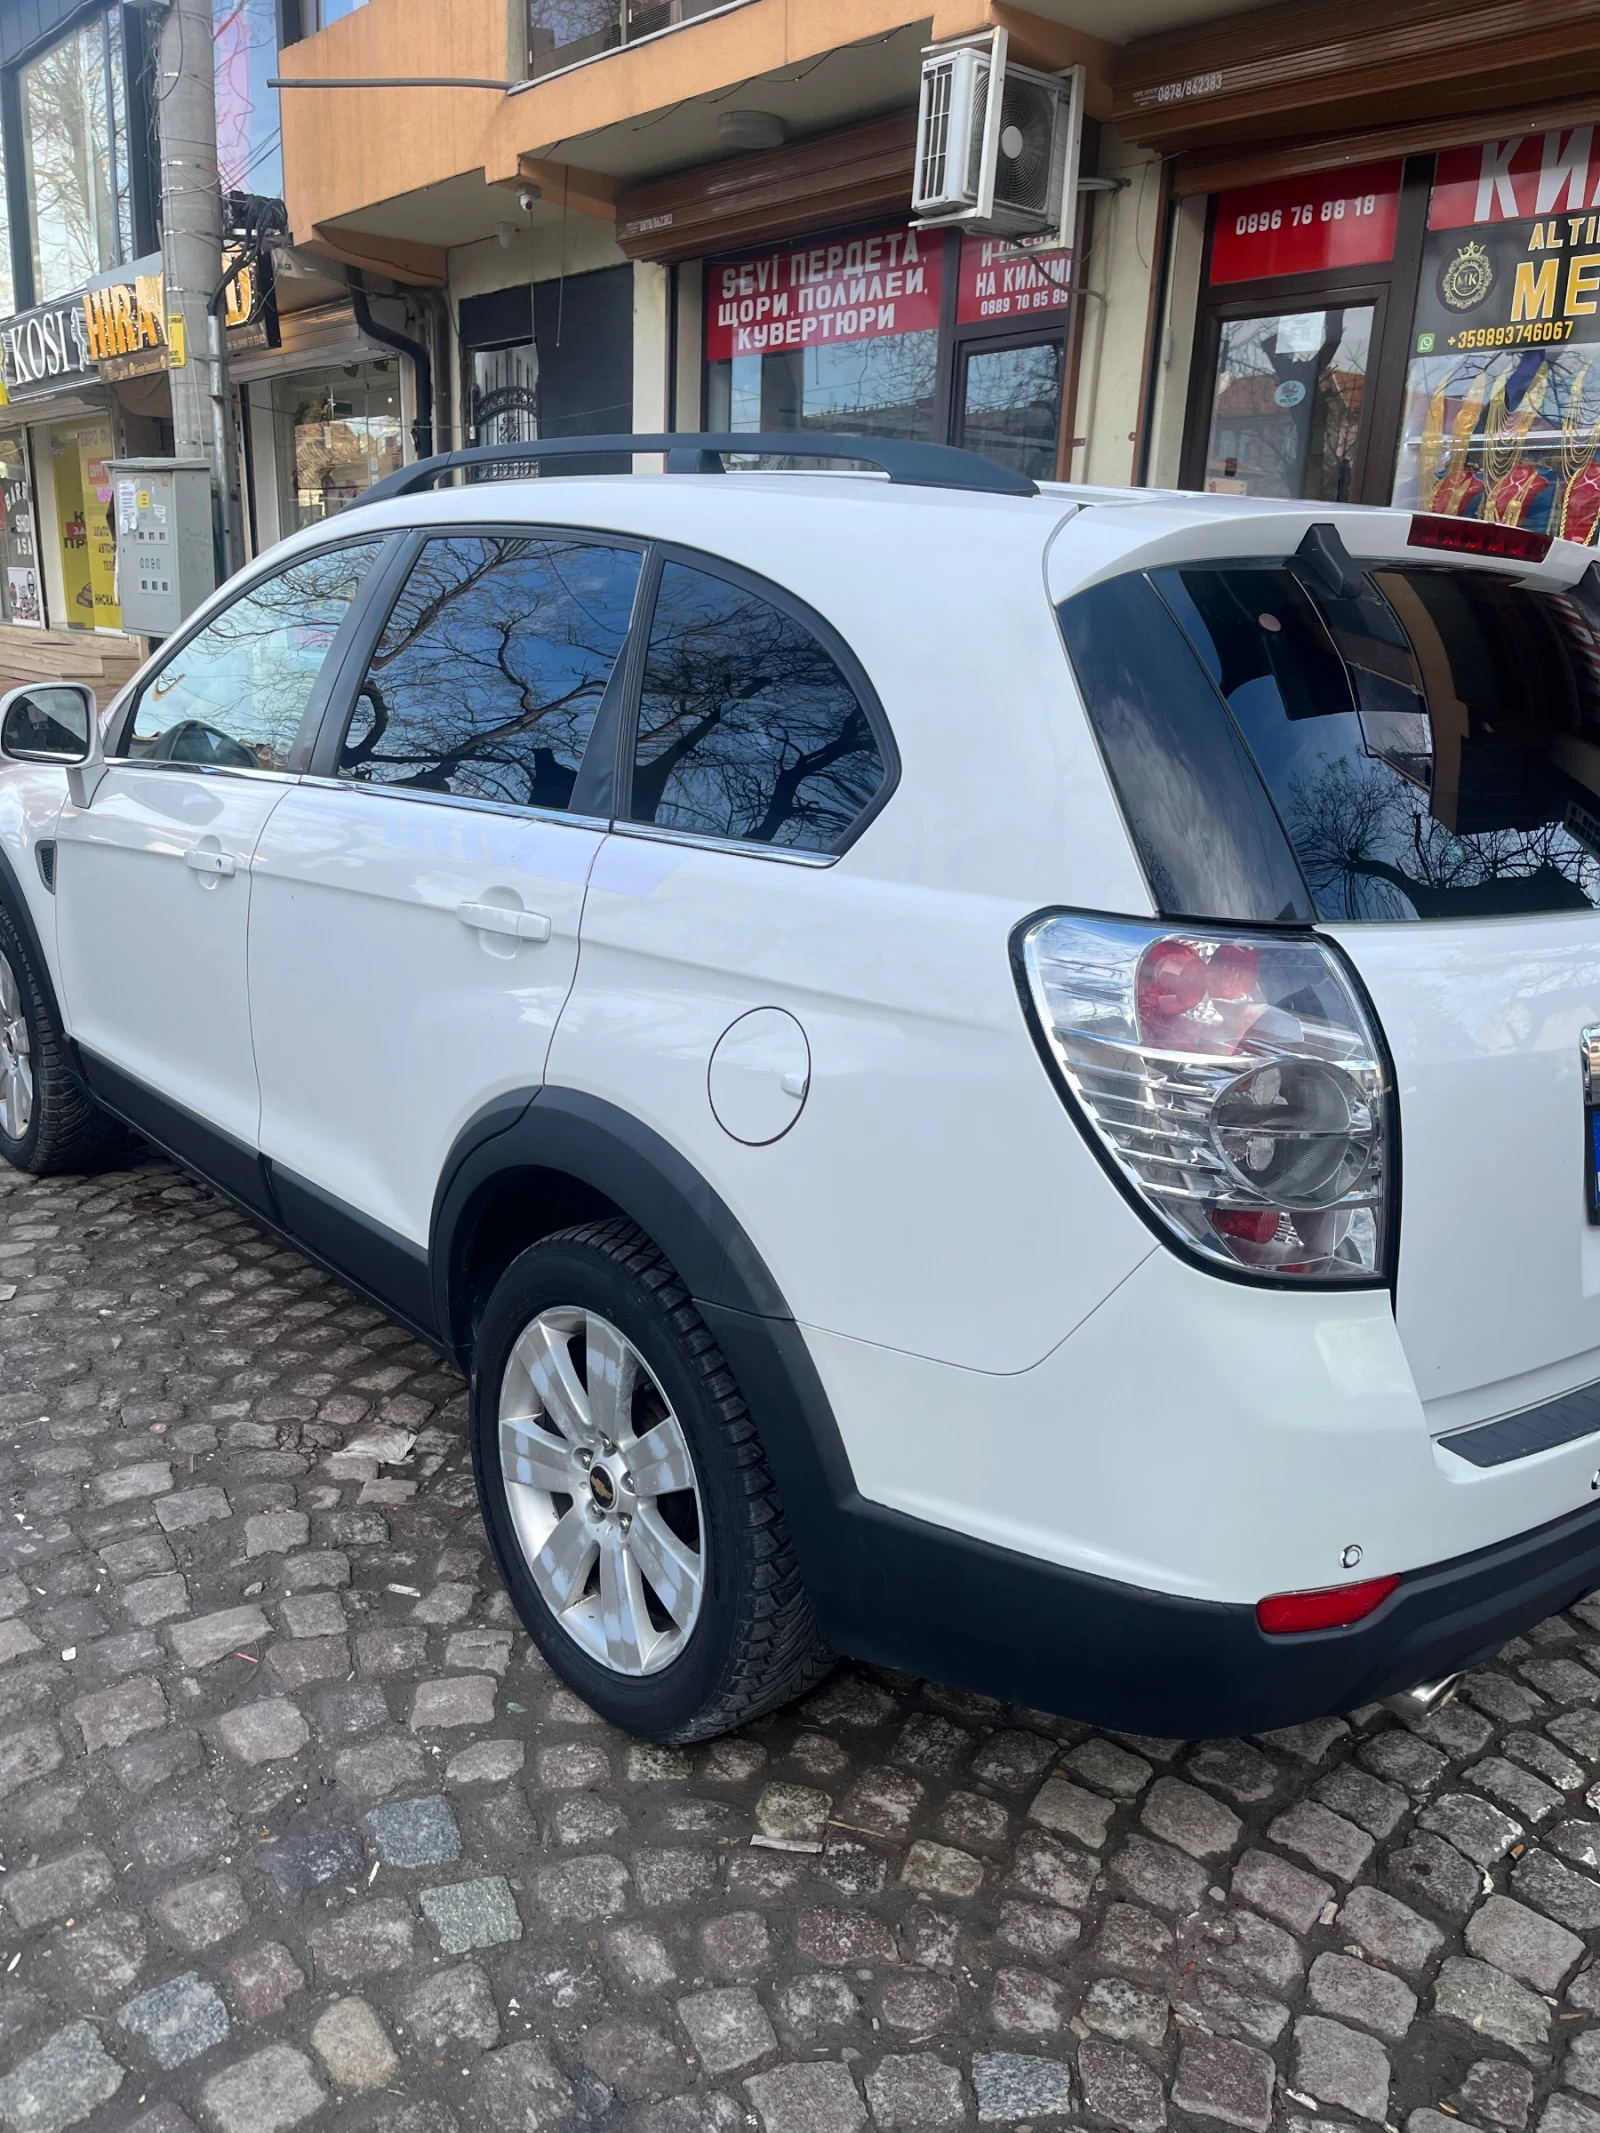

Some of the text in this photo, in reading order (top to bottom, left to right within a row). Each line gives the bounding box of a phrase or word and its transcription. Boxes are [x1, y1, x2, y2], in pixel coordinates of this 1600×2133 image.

[1157, 73, 1223, 102] 0878/862383
[1473, 126, 1600, 223] КИ
[1235, 194, 1376, 236] 0896 76 88 18
[1527, 215, 1600, 251] ALTI
[789, 229, 927, 288] ПЕРДЕТА,
[975, 271, 996, 298] НА
[980, 289, 1069, 316] 0889 70 85 85
[737, 303, 896, 351] КУВЕРТЮРИ
[1447, 321, 1575, 349] +359893746067
[8, 310, 71, 385] KOSI
[64, 537, 88, 549] ПР
